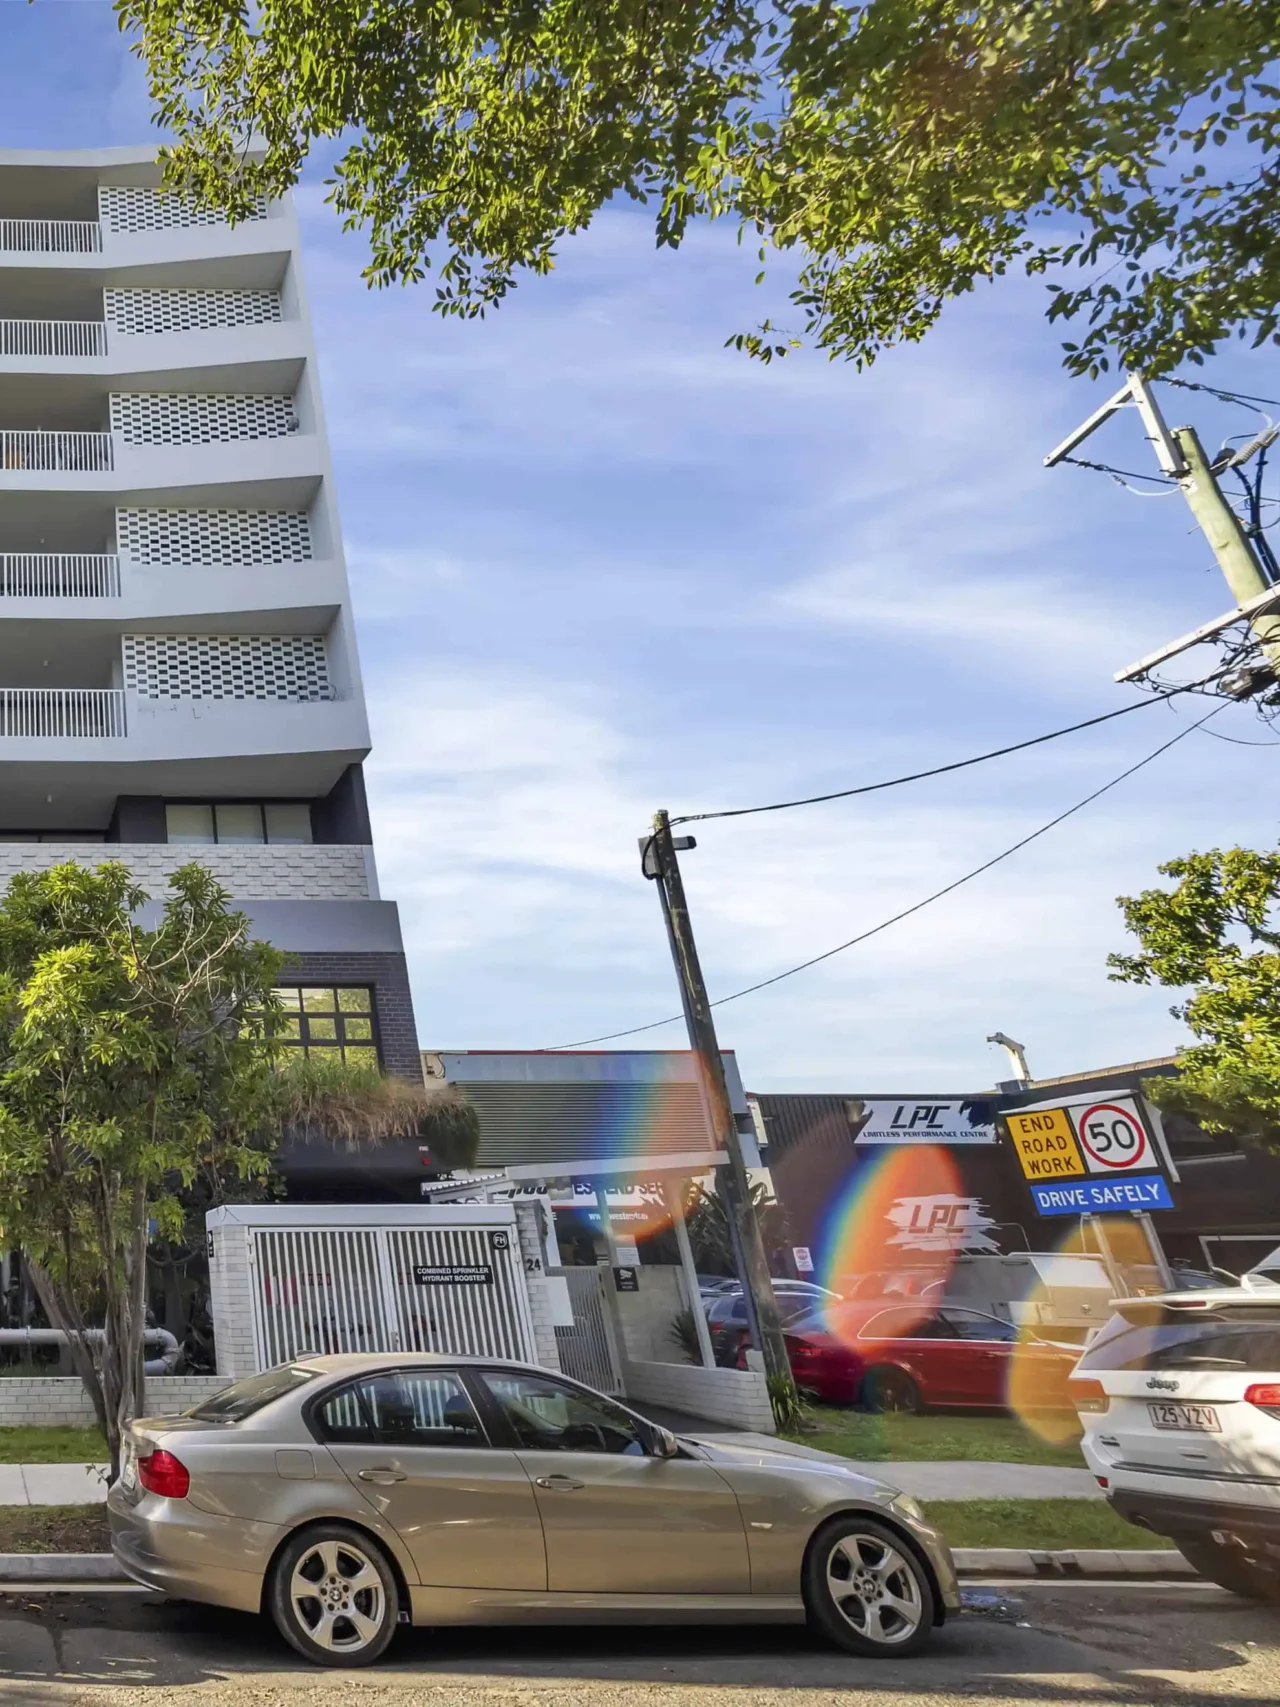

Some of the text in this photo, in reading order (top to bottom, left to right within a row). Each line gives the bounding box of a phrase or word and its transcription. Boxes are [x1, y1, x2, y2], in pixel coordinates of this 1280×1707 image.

[890, 1105, 950, 1129] LPC
[1020, 1115, 1055, 1133] END
[1022, 1136, 1068, 1154] ROAD
[1087, 1119, 1136, 1153] 50
[1027, 1156, 1077, 1175] WORK
[1038, 1183, 1159, 1208] DRIVE SAFELY
[908, 1204, 970, 1234] LPC
[494, 1236, 507, 1244] FH
[526, 1258, 541, 1271] 24
[454, 1274, 486, 1282] BOOSTER
[1146, 1377, 1180, 1392] Jeep
